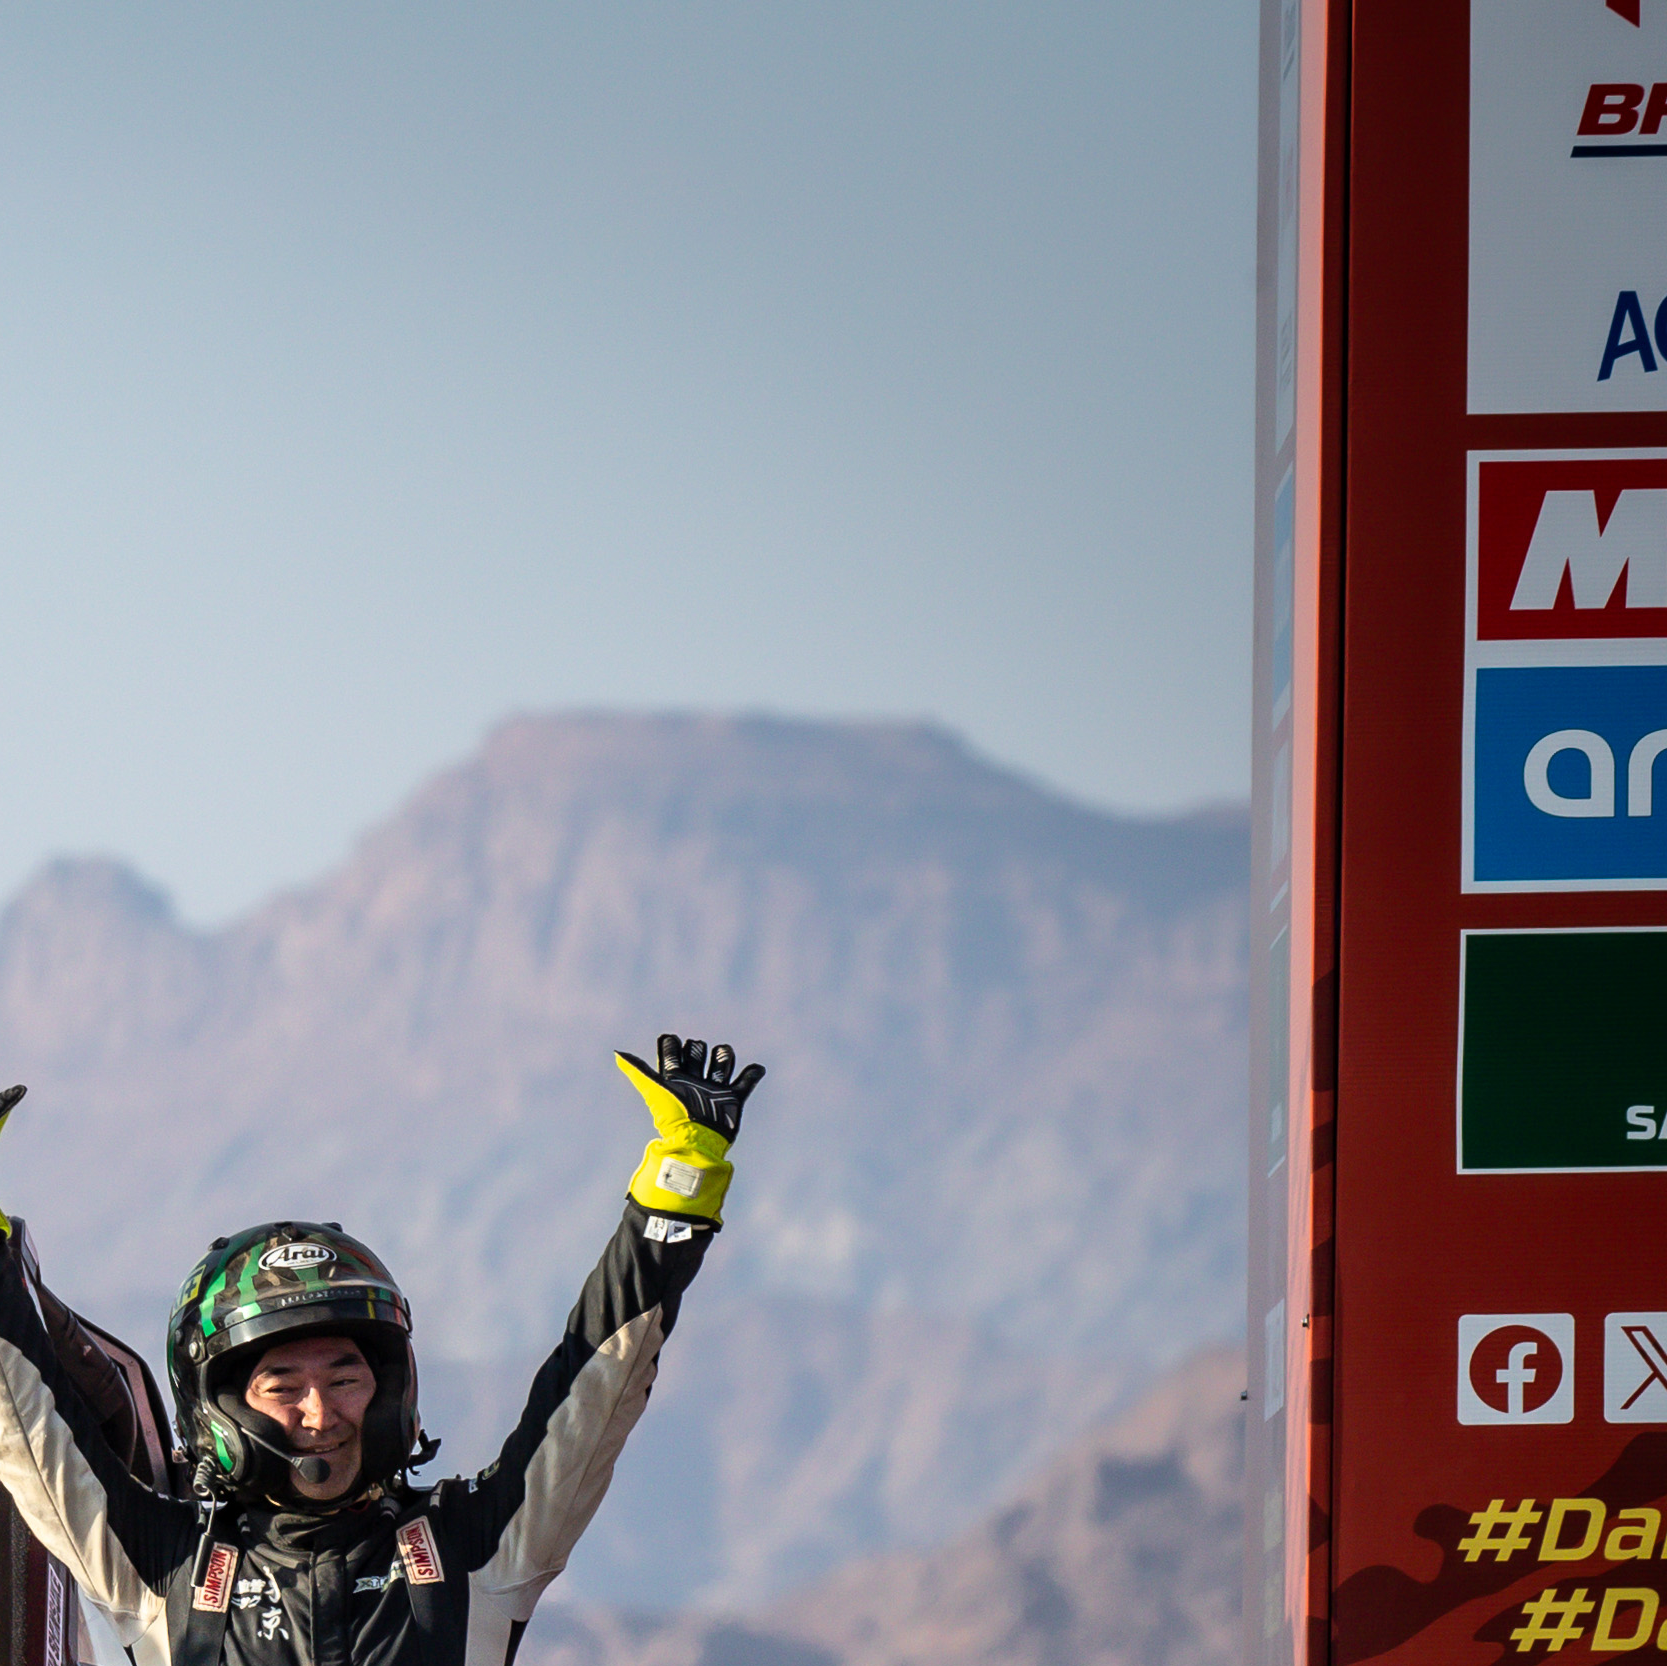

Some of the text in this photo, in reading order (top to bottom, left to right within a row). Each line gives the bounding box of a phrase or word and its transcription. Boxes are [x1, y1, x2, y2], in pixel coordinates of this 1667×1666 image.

[1596, 290, 1667, 382] A
[268, 1246, 327, 1266] Arai
[1456, 1497, 1667, 1563] #Da
[203, 1549, 228, 1604] SIMPSON
